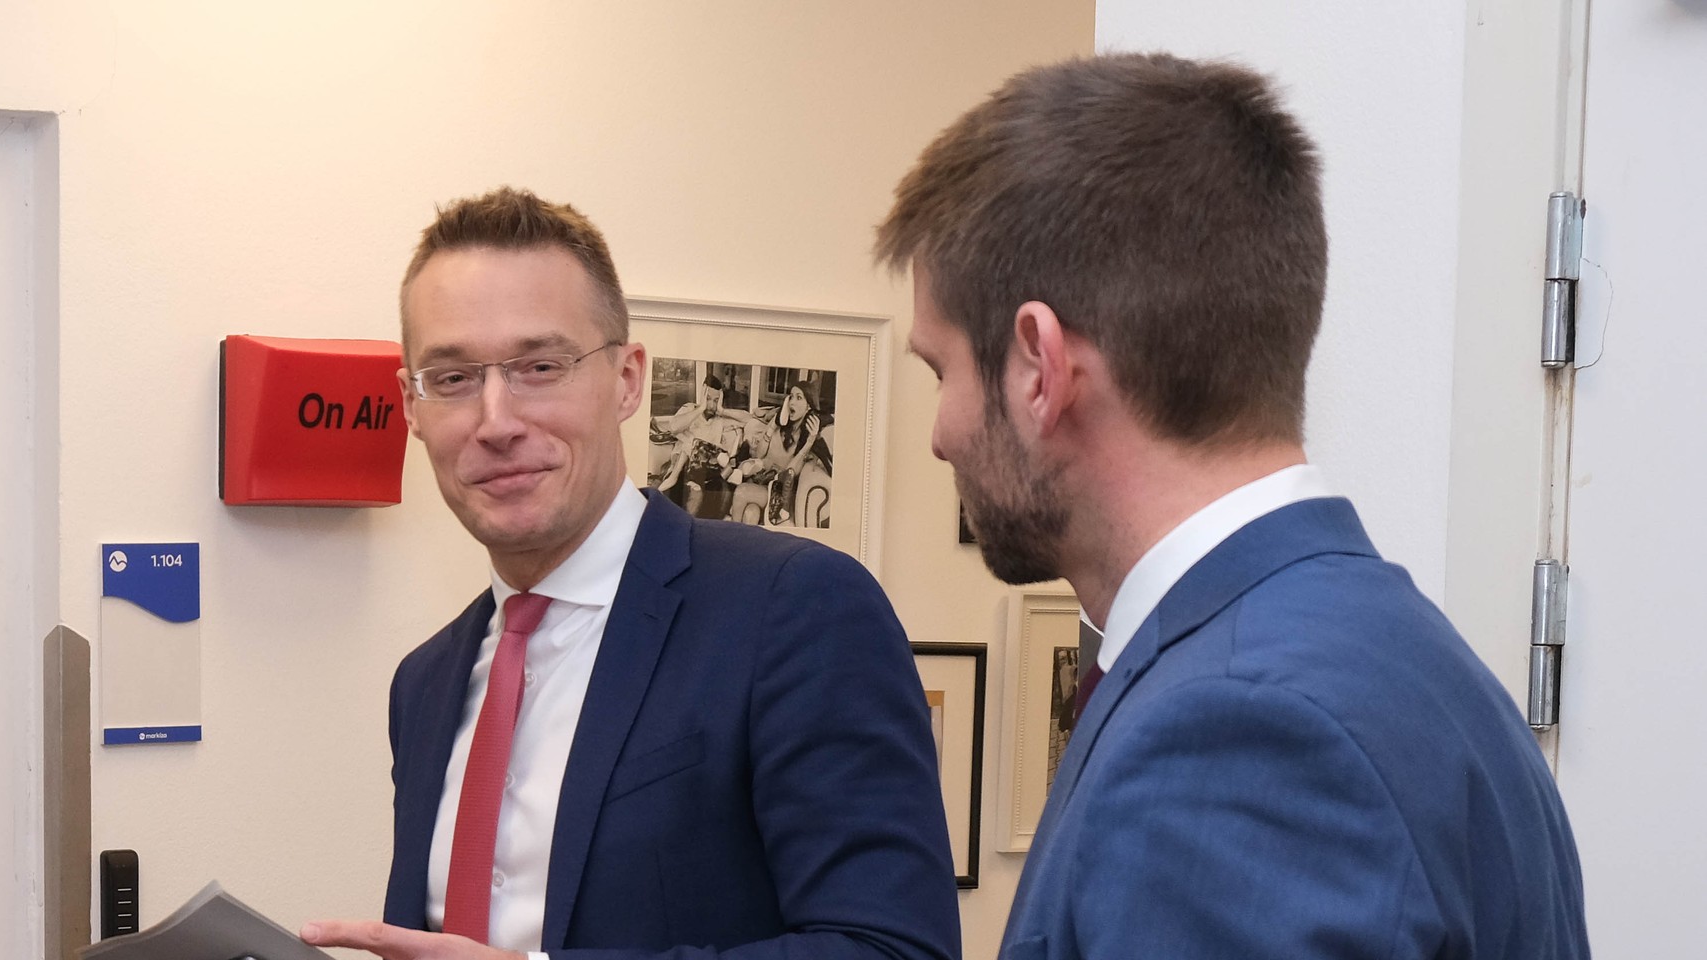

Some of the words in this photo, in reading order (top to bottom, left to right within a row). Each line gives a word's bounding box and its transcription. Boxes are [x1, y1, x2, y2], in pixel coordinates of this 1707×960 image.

[298, 392, 344, 429] On
[351, 395, 394, 430] Air
[150, 554, 183, 567] 1.104
